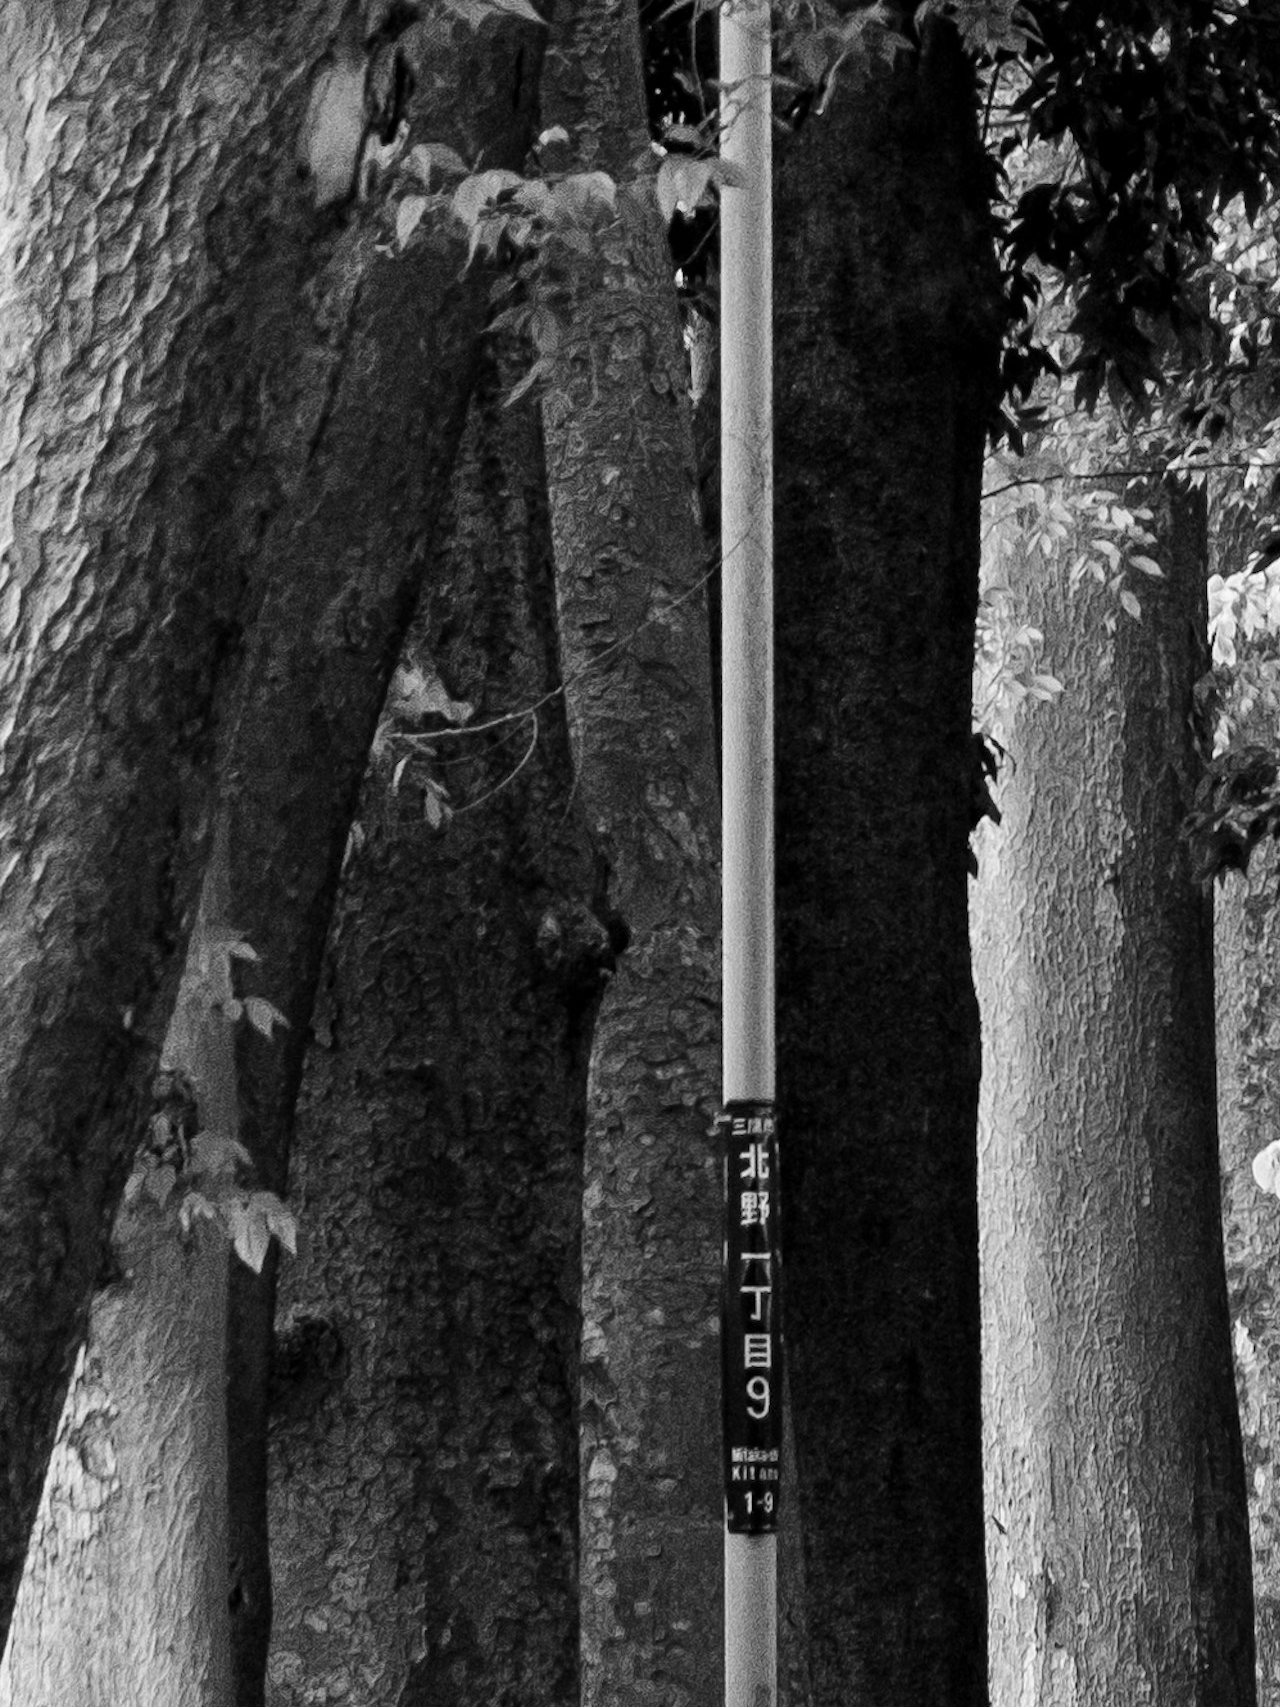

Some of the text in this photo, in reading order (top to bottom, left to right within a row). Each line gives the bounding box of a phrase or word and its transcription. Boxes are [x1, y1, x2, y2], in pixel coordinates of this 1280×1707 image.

[740, 1143, 771, 1418] 北野一丁目9
[745, 1491, 773, 1514] 1-9
